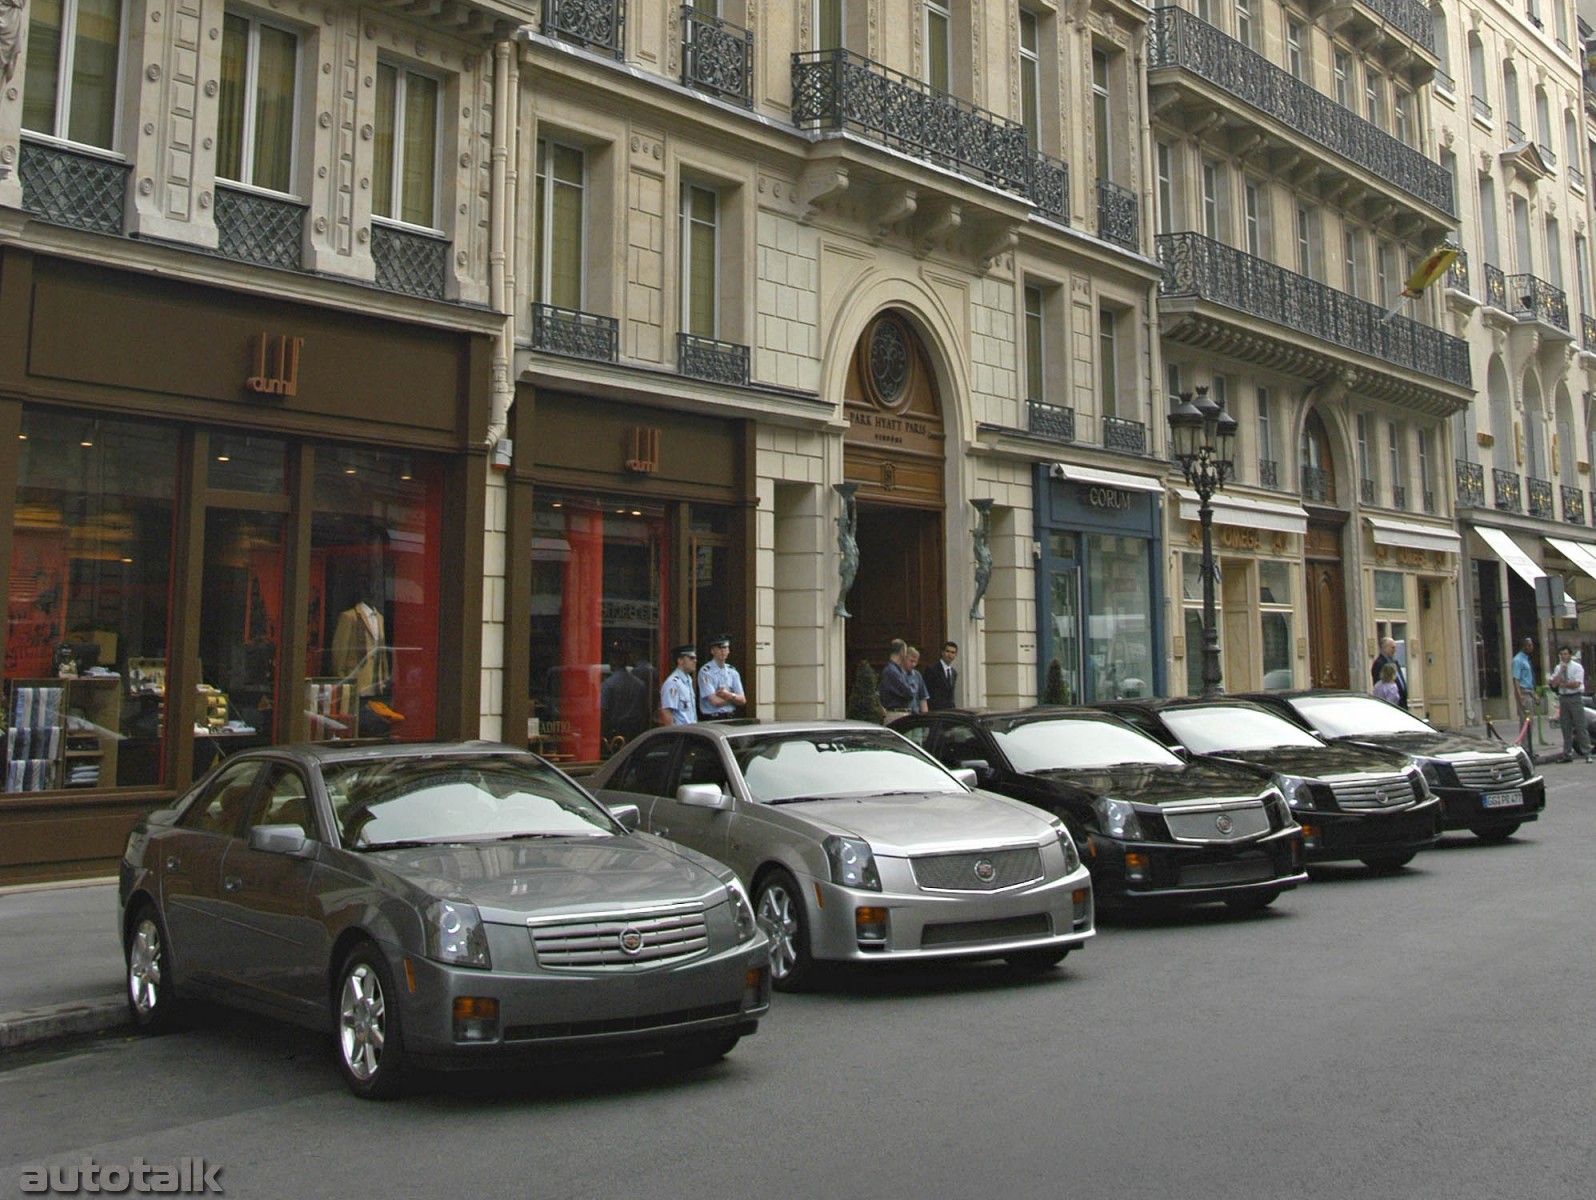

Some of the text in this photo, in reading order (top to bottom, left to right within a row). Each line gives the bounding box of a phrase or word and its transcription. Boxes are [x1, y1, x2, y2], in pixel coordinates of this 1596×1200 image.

[246, 332, 304, 396] dunhill
[850, 412, 926, 434] PARK HYATT PARIS
[1090, 487, 1130, 510] CORUM
